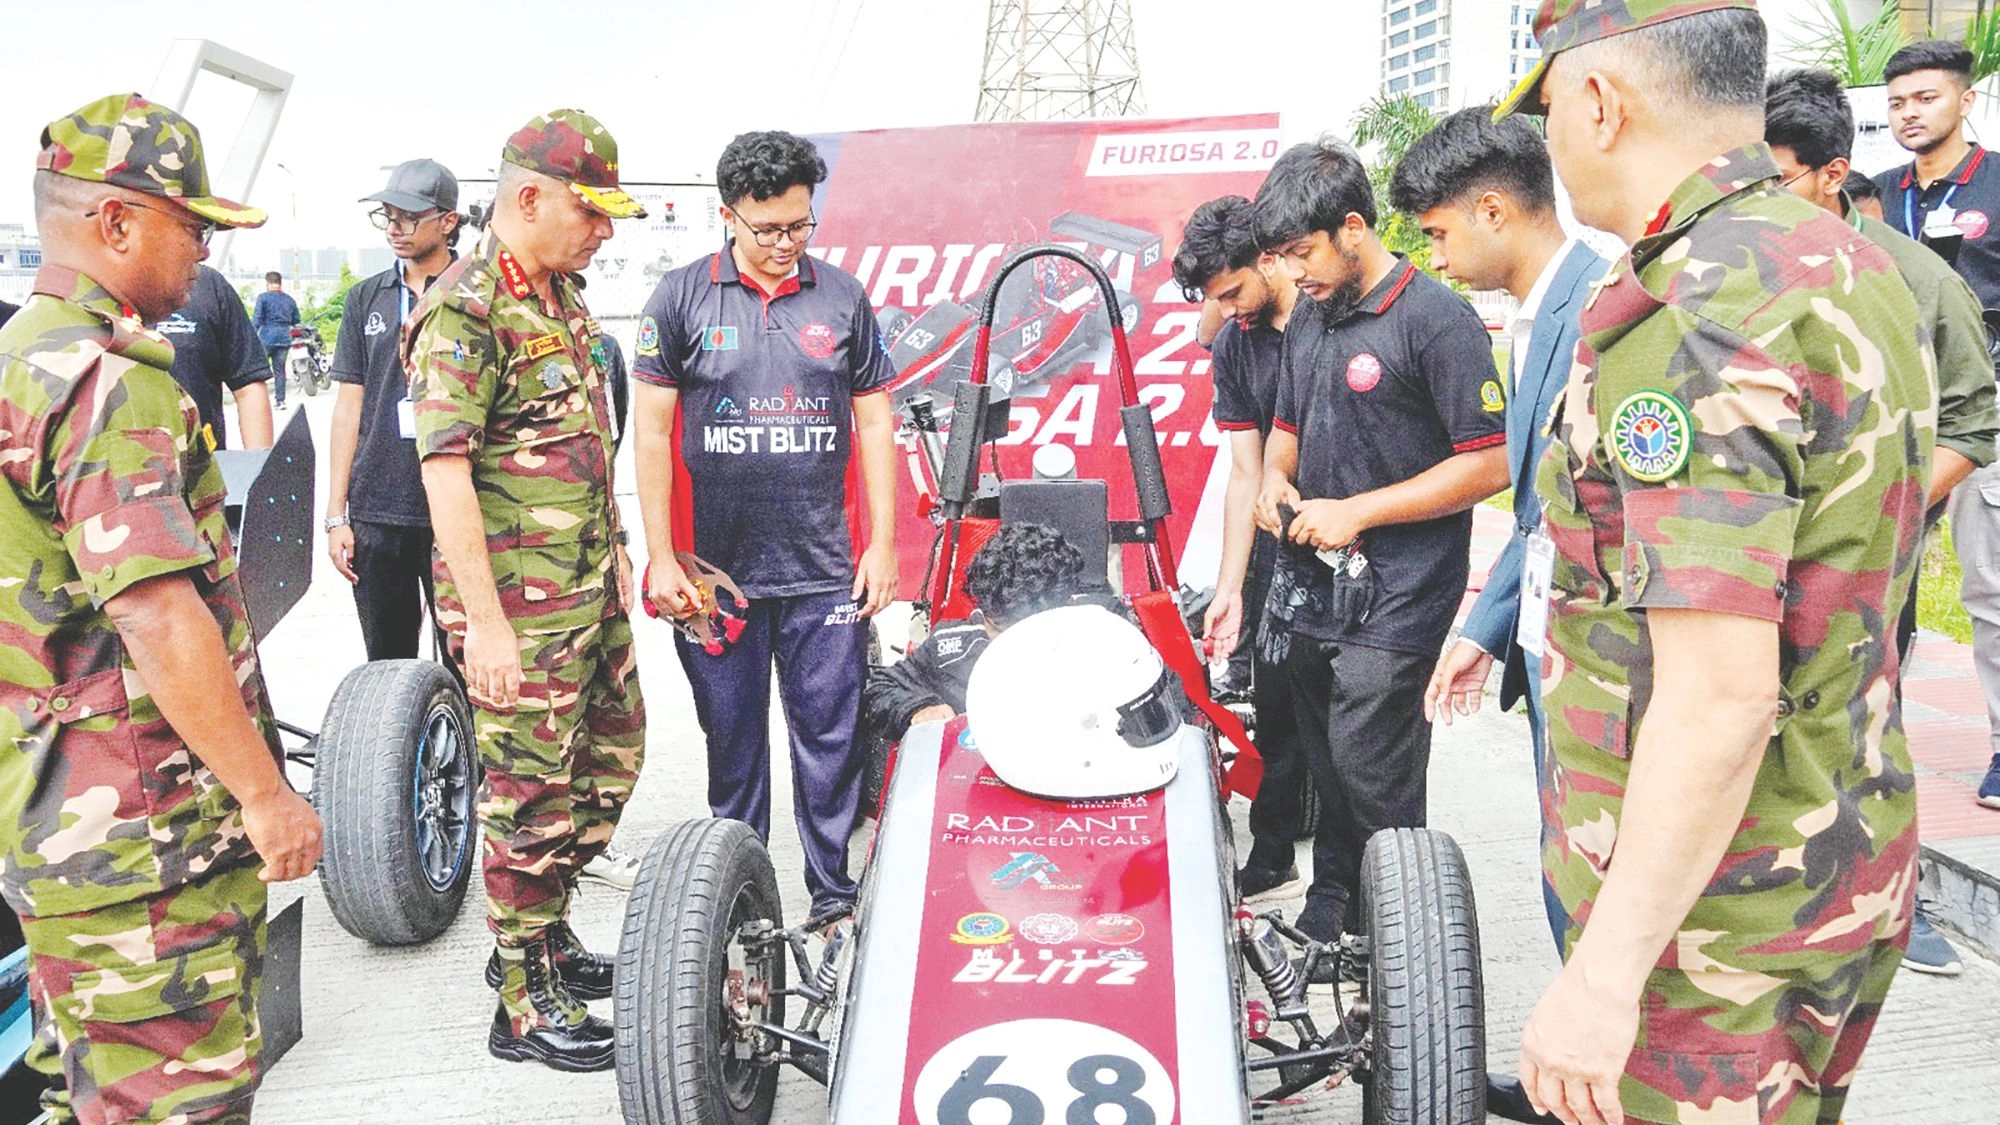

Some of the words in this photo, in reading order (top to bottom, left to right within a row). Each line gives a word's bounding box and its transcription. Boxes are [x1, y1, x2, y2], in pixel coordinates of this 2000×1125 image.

[1102, 143, 1223, 165] FURIOSA
[1233, 139, 1279, 160] 2.0
[1144, 243, 1160, 267] 63
[904, 328, 935, 350] 63
[1021, 319, 1042, 347] 63
[1133, 311, 1213, 375] 2.
[704, 425, 765, 454] MIST
[770, 425, 837, 454] BLITZ
[824, 613, 861, 626] BLIT
[834, 602, 858, 615] MIST
[942, 833, 1151, 847] PHARMACEUTICALS
[1039, 883, 1083, 891] GROUP
[951, 958, 1149, 985] BLITZ
[936, 1054, 1156, 1125] 68
